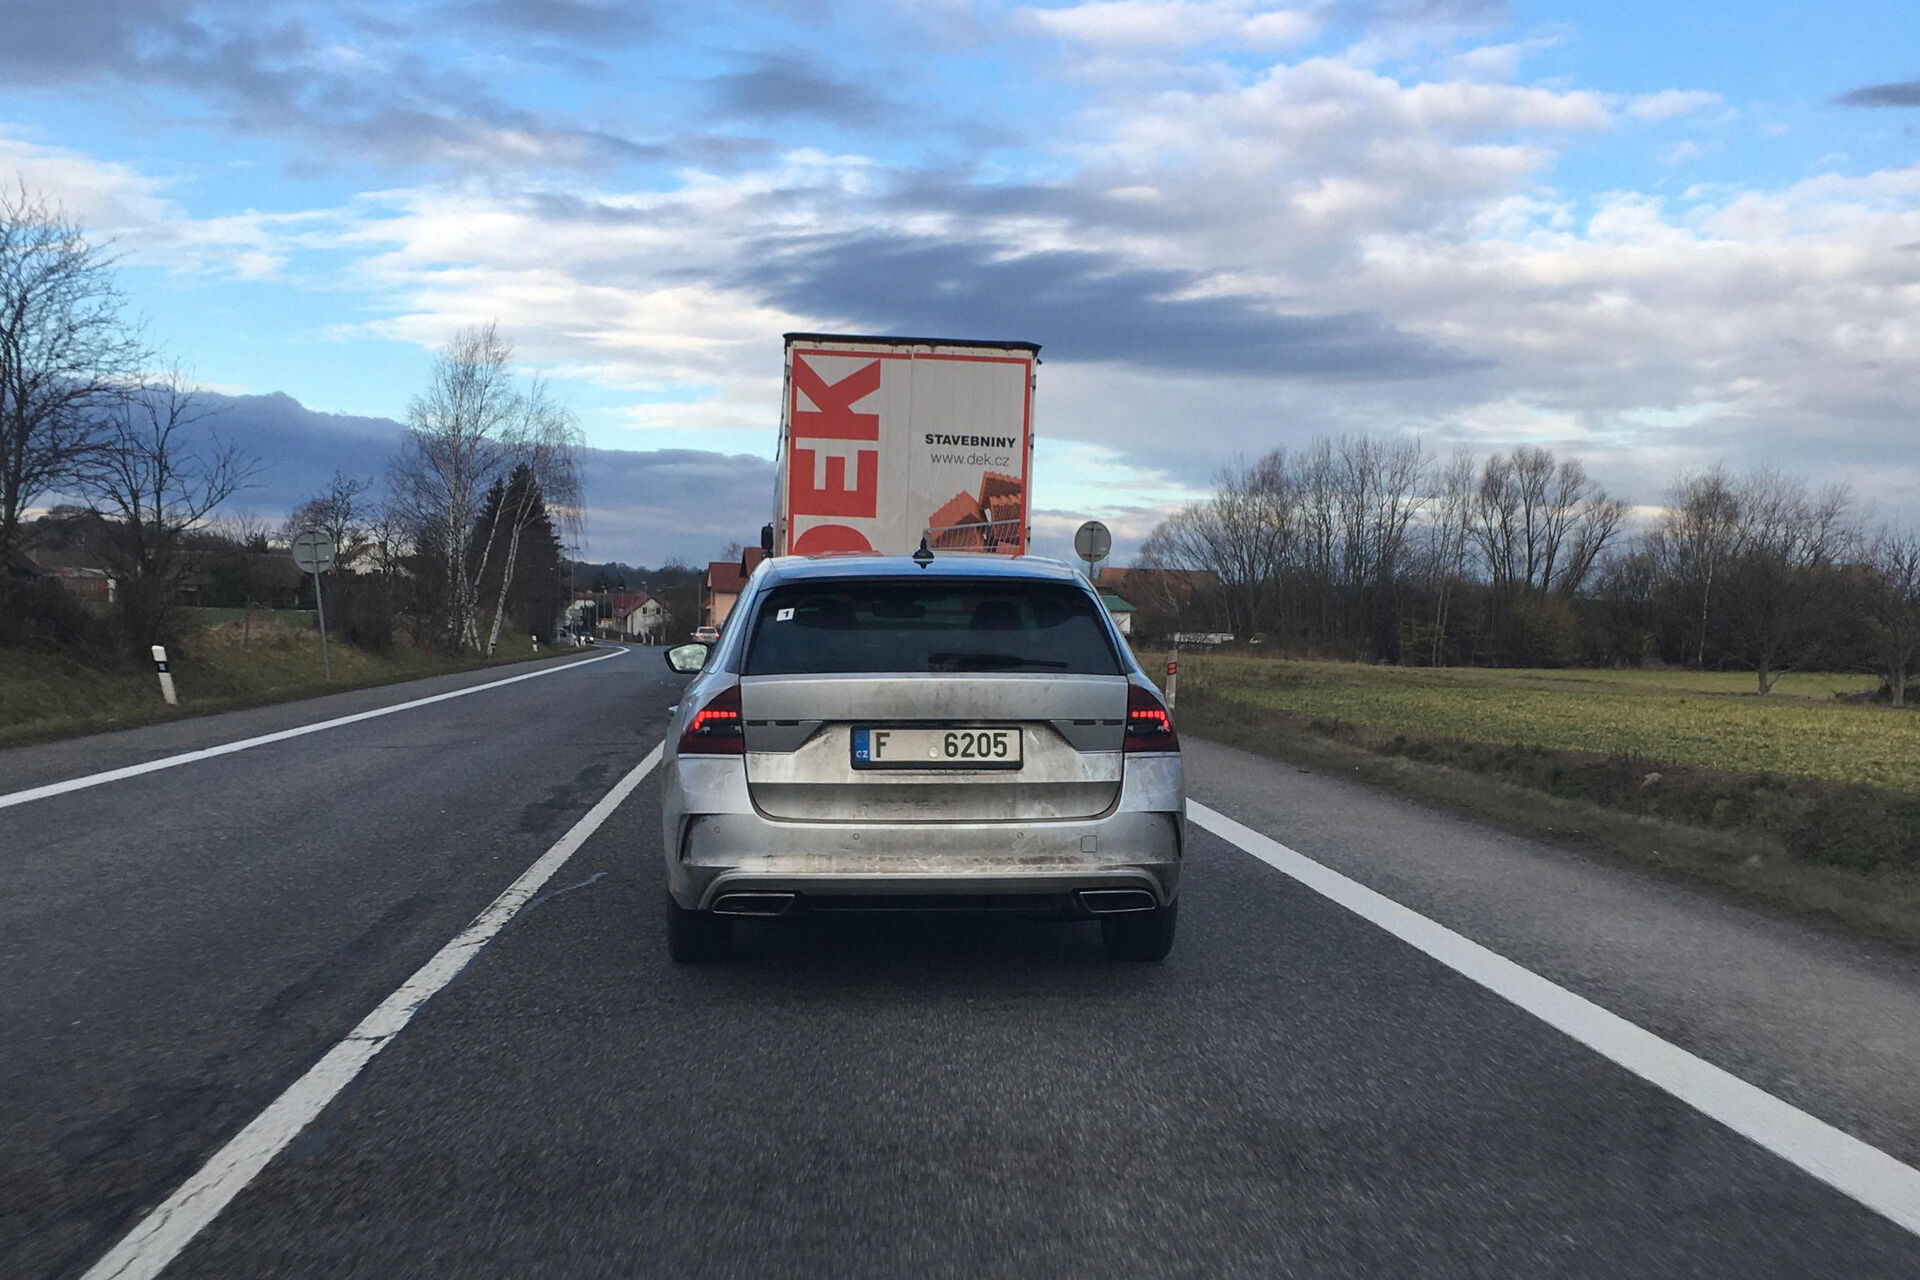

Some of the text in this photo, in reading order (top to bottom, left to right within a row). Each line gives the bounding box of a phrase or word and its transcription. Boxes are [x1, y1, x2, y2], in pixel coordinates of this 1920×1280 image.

[925, 433, 1016, 448] STAVEBNINY
[931, 453, 1010, 467] www.dek.cz
[875, 732, 1008, 758] F 6205
[856, 750, 869, 758] CZ
